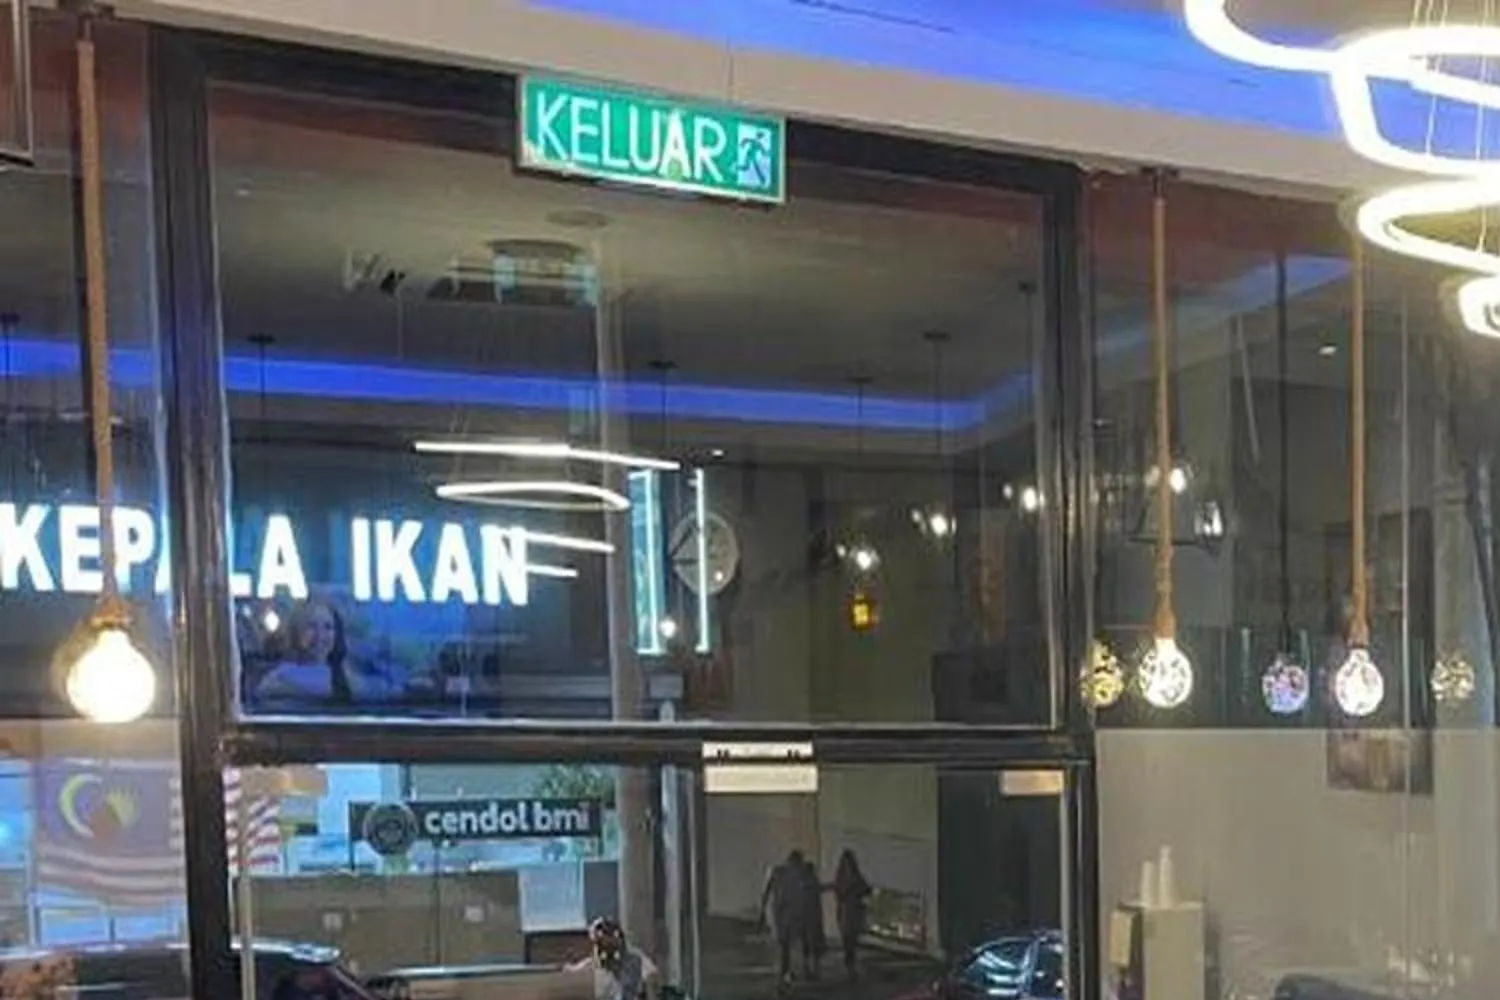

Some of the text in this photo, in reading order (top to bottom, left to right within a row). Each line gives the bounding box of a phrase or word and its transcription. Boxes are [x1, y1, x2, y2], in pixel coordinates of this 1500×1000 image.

[536, 90, 724, 184] KELUAR
[351, 517, 529, 606] IKAN
[424, 802, 530, 834] cendol
